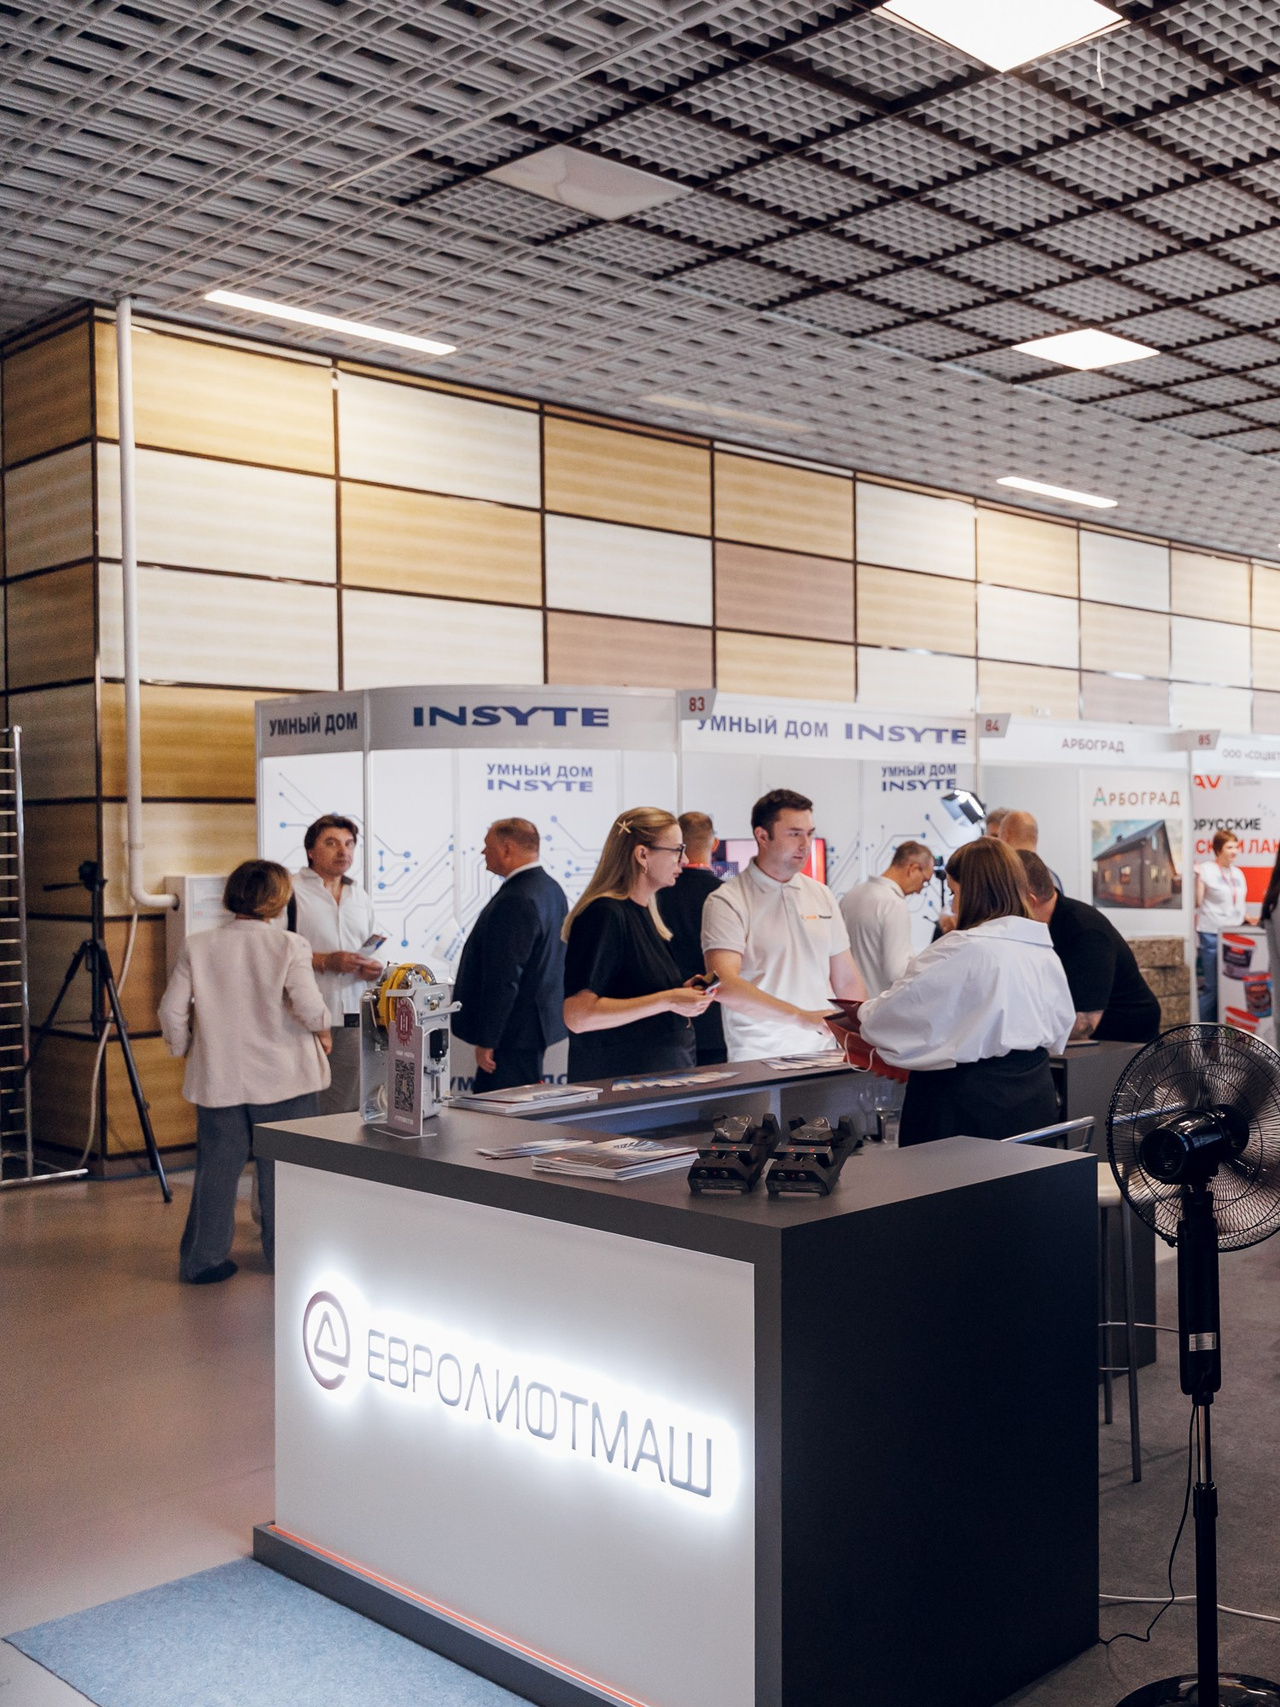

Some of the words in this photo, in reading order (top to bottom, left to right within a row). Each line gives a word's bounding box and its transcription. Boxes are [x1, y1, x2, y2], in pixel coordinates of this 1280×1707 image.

[688, 696, 706, 712] 83
[413, 706, 609, 727] INSYTE
[269, 713, 321, 737] УМНЫЙ
[325, 712, 358, 735] ДОМ
[698, 715, 777, 734] УМНЫЙ
[784, 719, 829, 739] ДОМ
[845, 722, 967, 745] INSYTE
[985, 719, 1000, 732] 84
[1061, 738, 1125, 753] АРБОГРАД
[486, 763, 551, 777] УМНЫЙ
[556, 765, 593, 778] ДОМ
[881, 763, 925, 777] УМНЫЙ
[929, 764, 957, 777] ДОМ
[486, 779, 593, 792] INSYTE
[881, 779, 957, 792] INSYTE
[1193, 818, 1262, 831] РУССКИЕ
[367, 1328, 713, 1499] ЕВРОЛИФТМАШ
